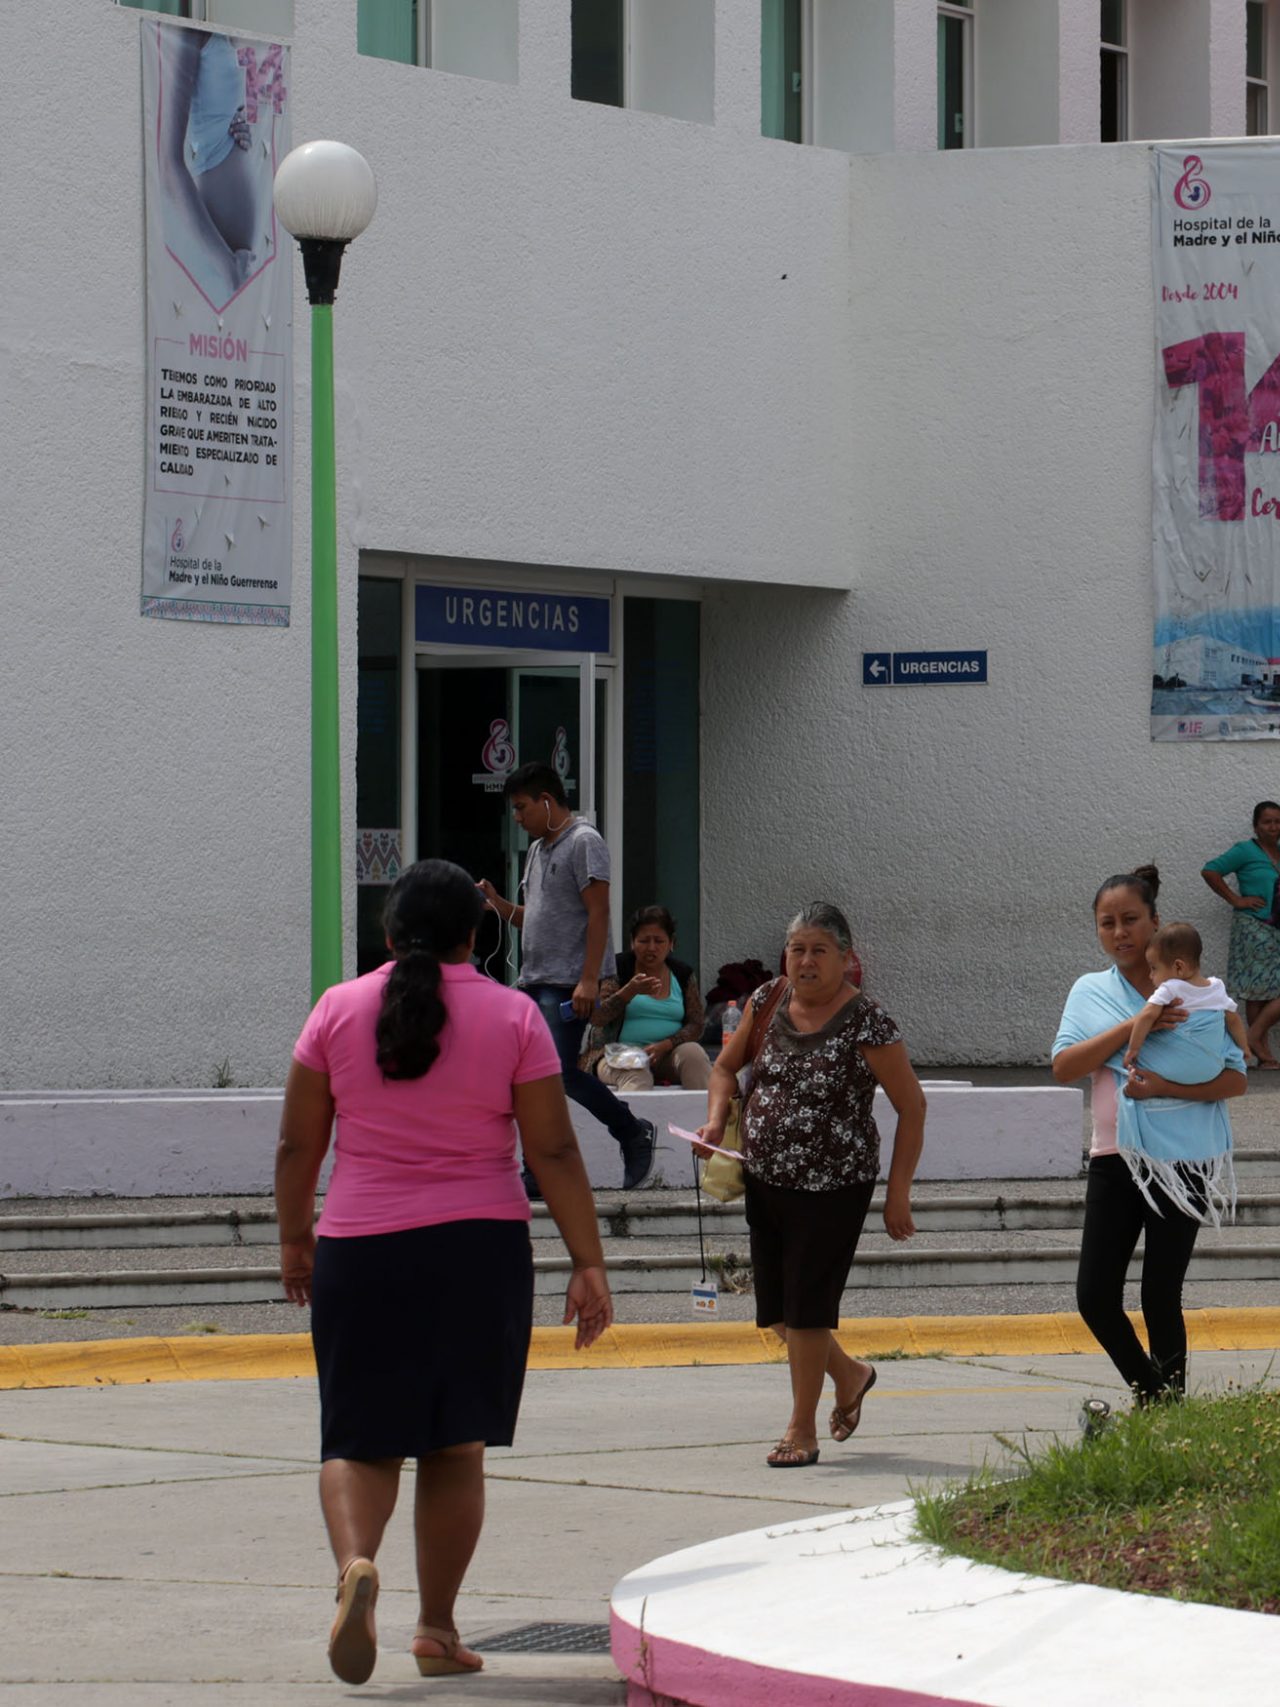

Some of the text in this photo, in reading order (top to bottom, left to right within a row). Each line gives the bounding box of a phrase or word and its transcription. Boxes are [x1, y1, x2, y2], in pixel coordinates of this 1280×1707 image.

[1173, 216, 1271, 233] Hospital de la
[1173, 232, 1217, 247] Madre
[1222, 235, 1230, 247] y
[1235, 231, 1247, 244] el
[1162, 282, 1238, 303] Desde 2004
[189, 332, 247, 362] MISIÓN
[161, 368, 276, 393] TEEMOS COMO PRIORDAD
[160, 388, 174, 400] LA
[177, 390, 232, 407] EMBARAZADA
[239, 398, 250, 409] DE
[196, 410, 202, 422] Y
[210, 411, 238, 425] RECIÉN
[187, 428, 204, 441] QUE
[206, 430, 248, 445] AMERITEN
[266, 454, 277, 466] DE
[170, 556, 222, 571] Hospital de la
[169, 570, 278, 589] Madre y el Niño Guerrerense
[446, 596, 580, 633] URGENCIAS
[900, 661, 980, 674] URGENCIAS
